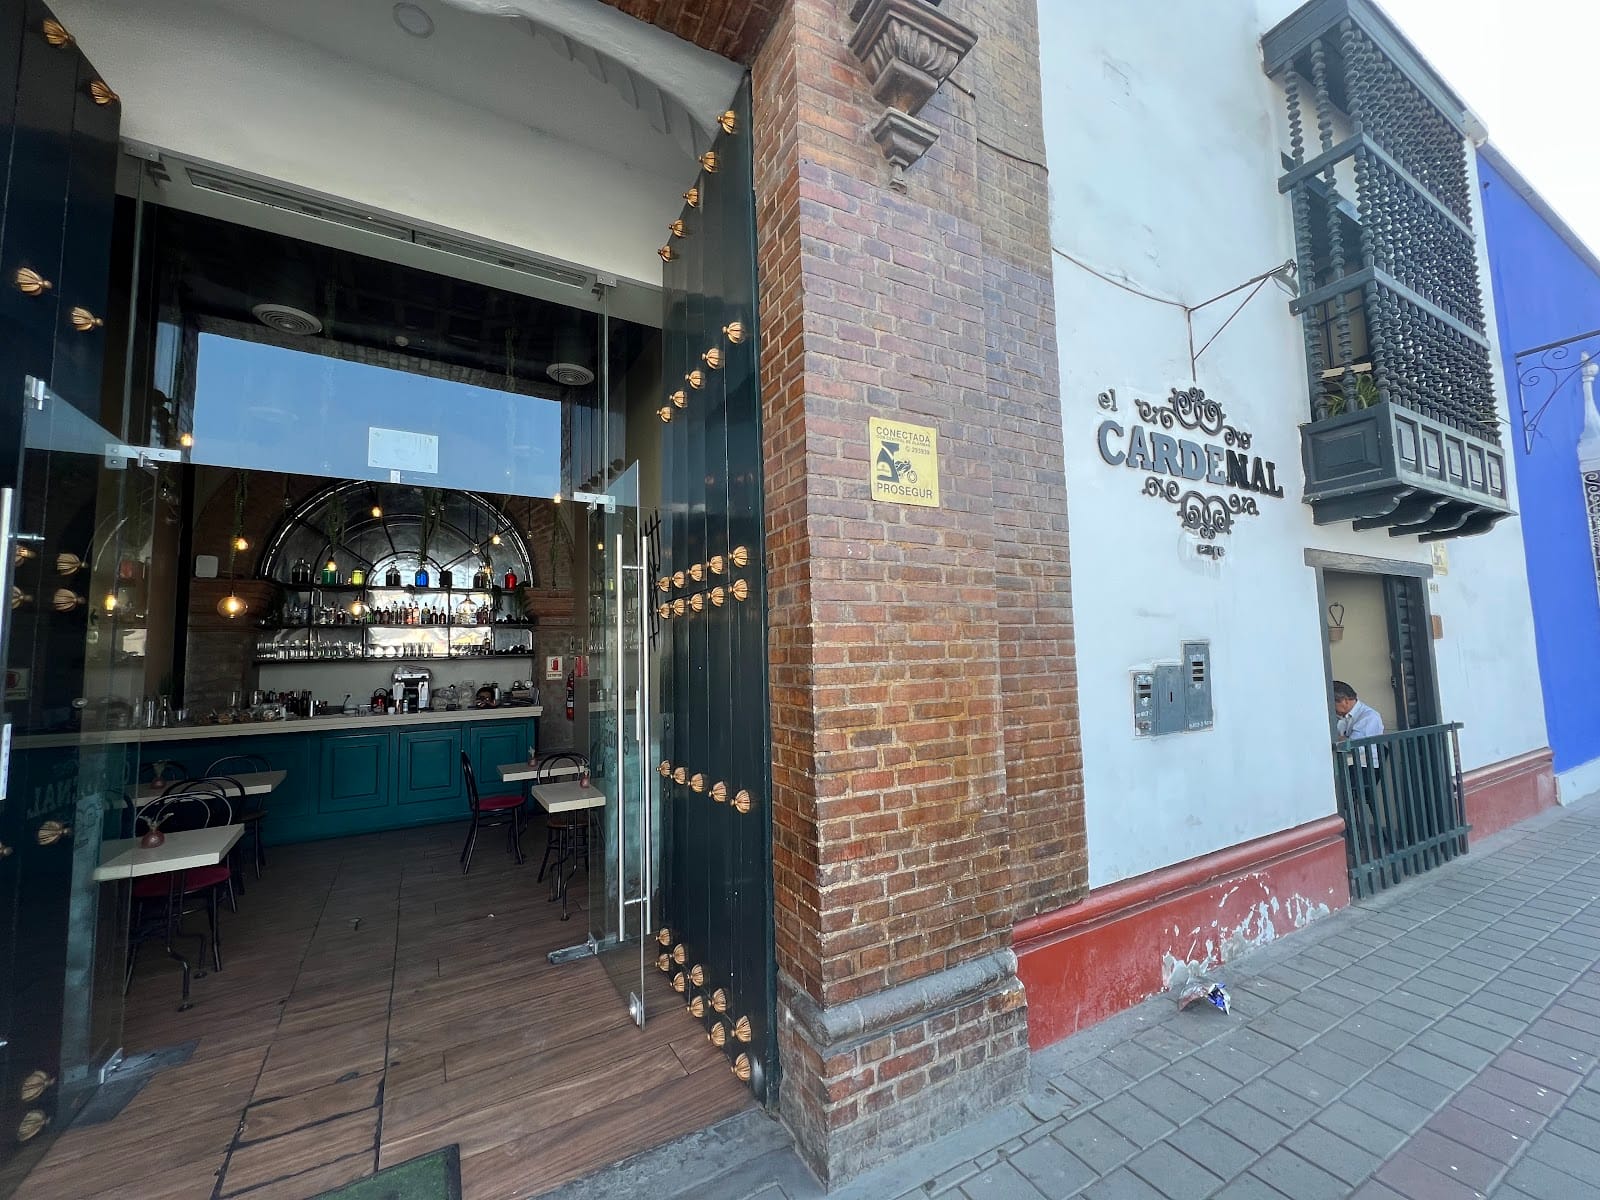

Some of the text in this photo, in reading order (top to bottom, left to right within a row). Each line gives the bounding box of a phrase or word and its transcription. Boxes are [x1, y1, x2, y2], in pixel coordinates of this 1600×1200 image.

[1098, 388, 1118, 412] el
[876, 426, 931, 443] CONECTADA
[1098, 420, 1284, 499] CARDENAL
[877, 482, 933, 499] PROSEGUR
